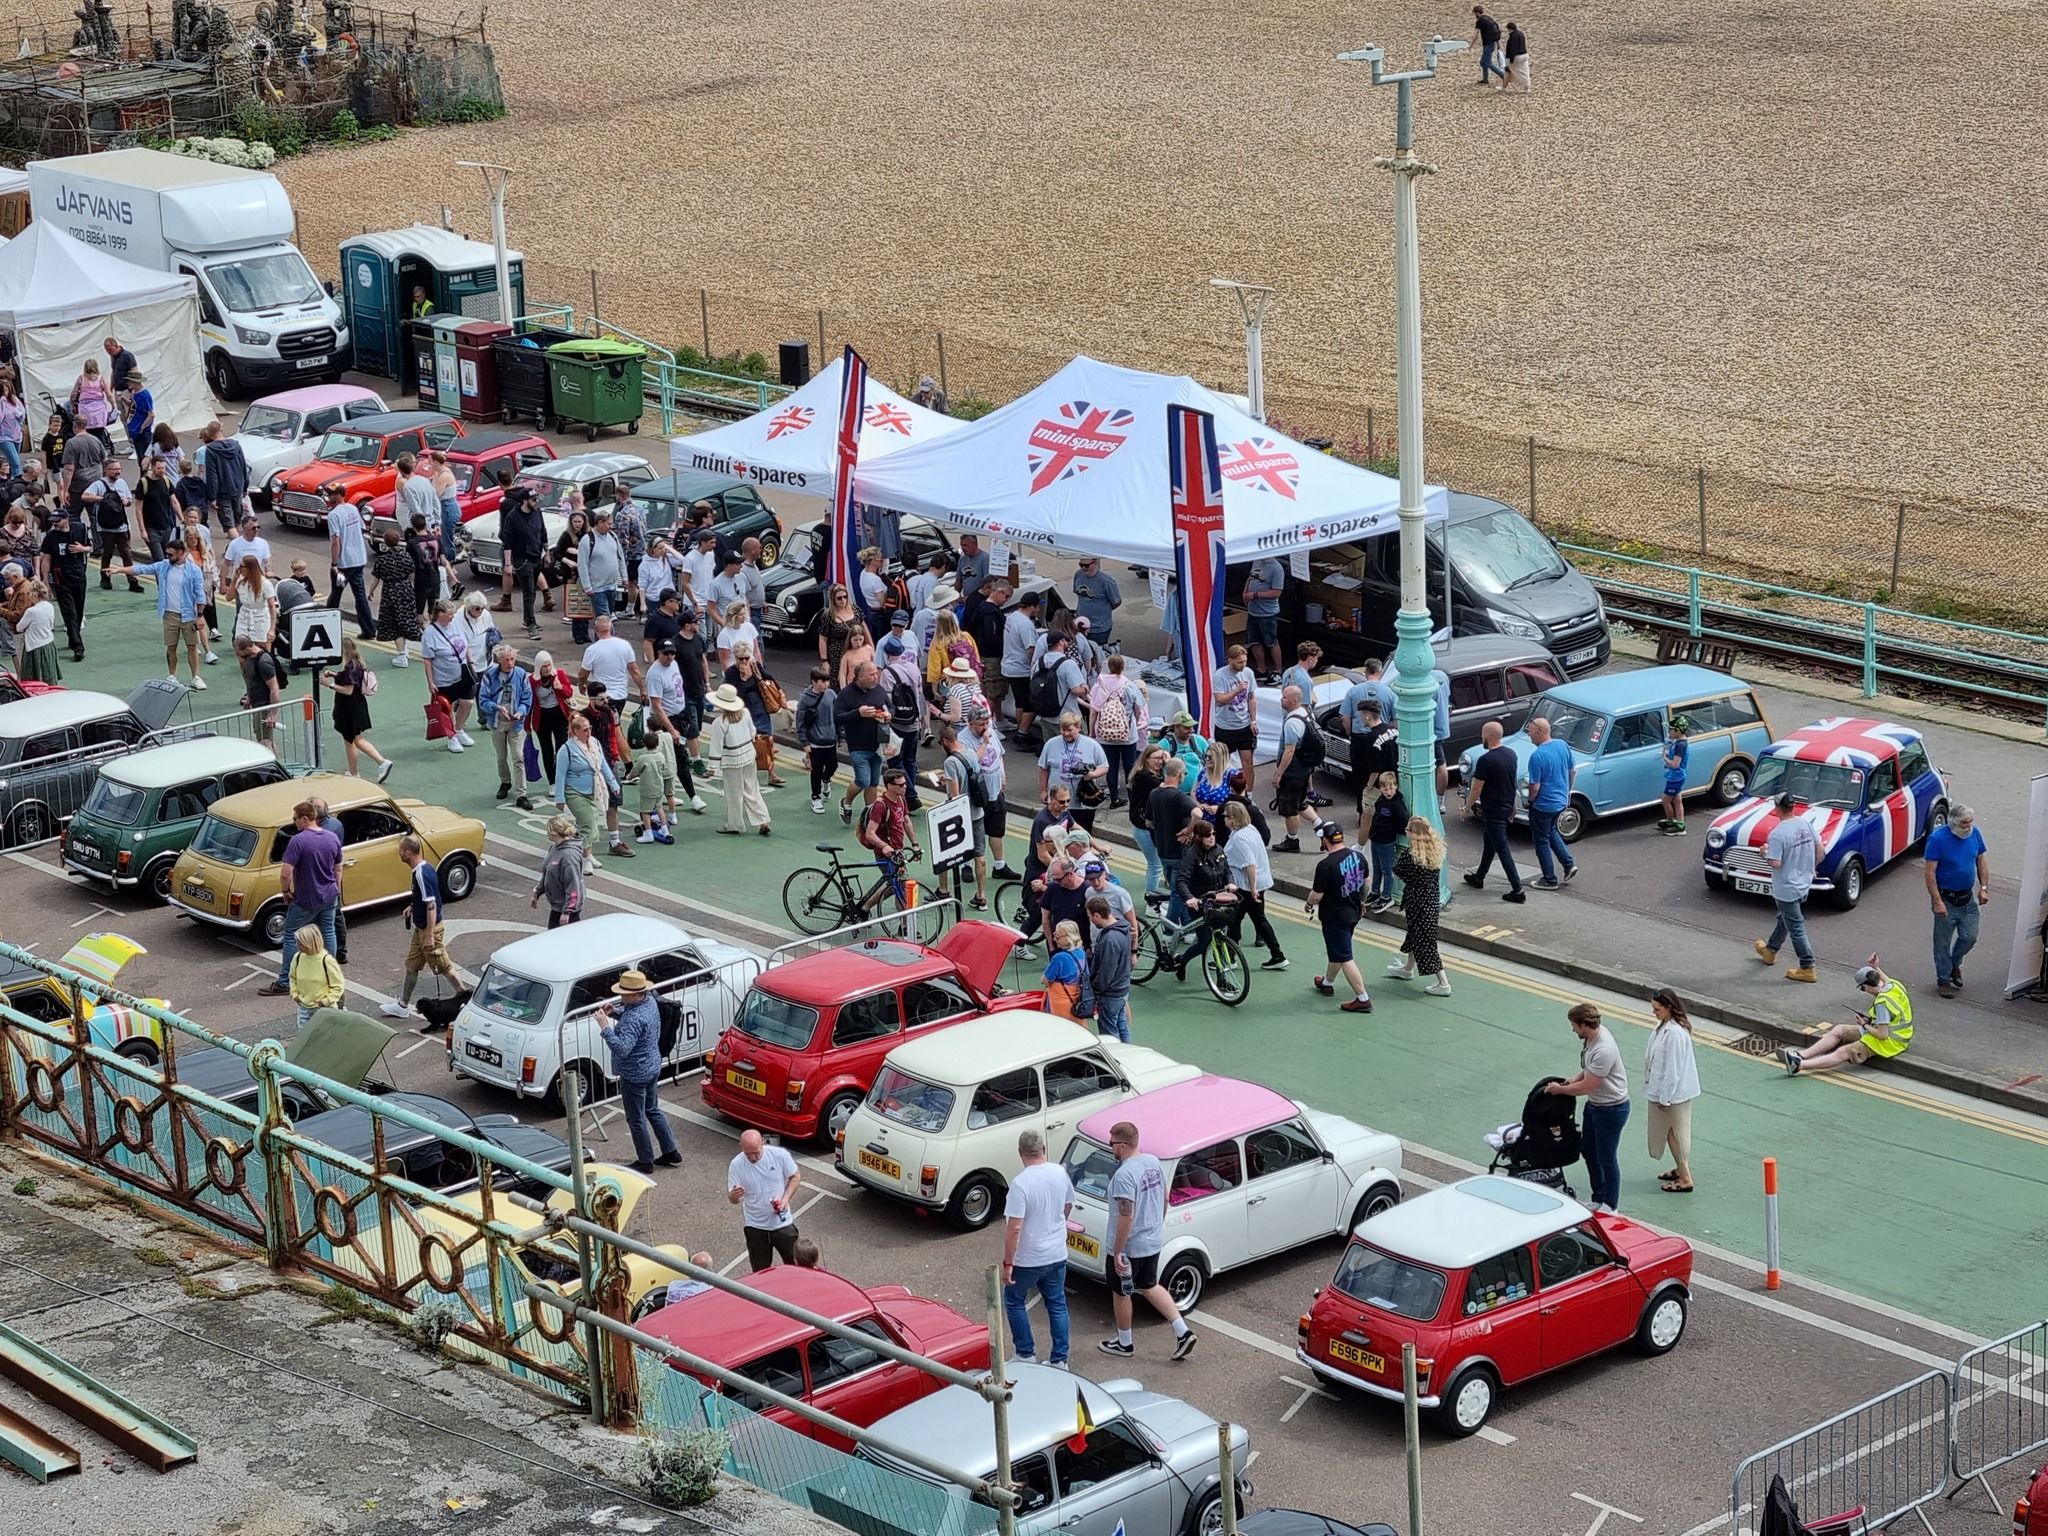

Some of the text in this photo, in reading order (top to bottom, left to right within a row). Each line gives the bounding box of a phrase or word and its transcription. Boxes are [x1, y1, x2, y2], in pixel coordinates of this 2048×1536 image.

[56, 184, 133, 225] JAFVANS
[86, 230, 107, 247] 8864
[108, 234, 127, 250] 1999
[1032, 425, 1119, 452] mini spares
[692, 452, 807, 487] mini spares
[1222, 455, 1296, 478] mini spares
[949, 511, 990, 529] mini
[1257, 512, 1380, 549] mini spares
[300, 623, 334, 652] A
[937, 814, 966, 853] B
[1738, 880, 1761, 892] B127
[743, 1077, 758, 1093] ERA
[861, 1152, 881, 1169] B946
[1076, 1238, 1094, 1255] PNK
[1331, 1340, 1383, 1371] F696 RPK
